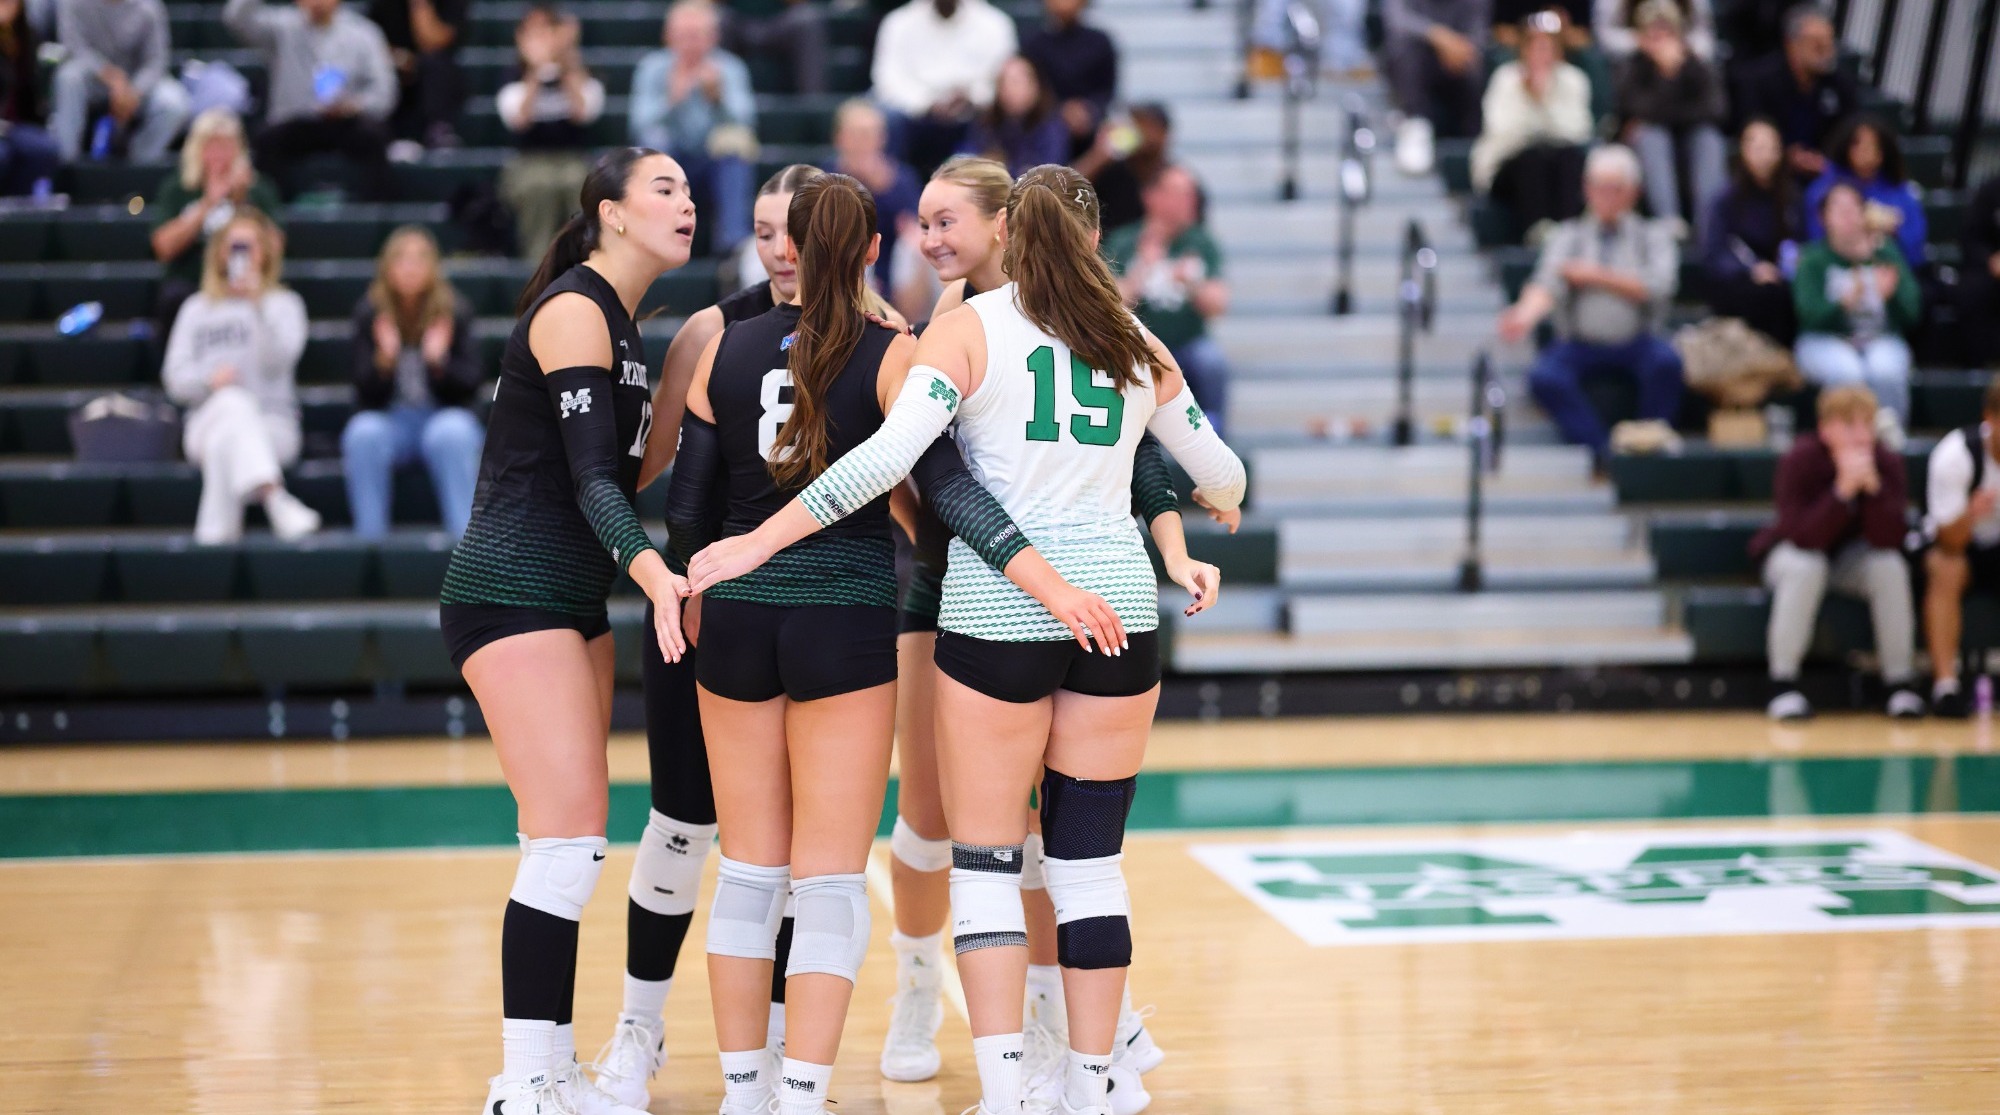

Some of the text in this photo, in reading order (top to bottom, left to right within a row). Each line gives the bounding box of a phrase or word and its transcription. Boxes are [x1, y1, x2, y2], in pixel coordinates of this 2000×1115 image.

[1026, 345, 1125, 446] 15
[530, 1074, 545, 1085] NIKE
[725, 1070, 758, 1083] capelli
[782, 1076, 815, 1090] capelli
